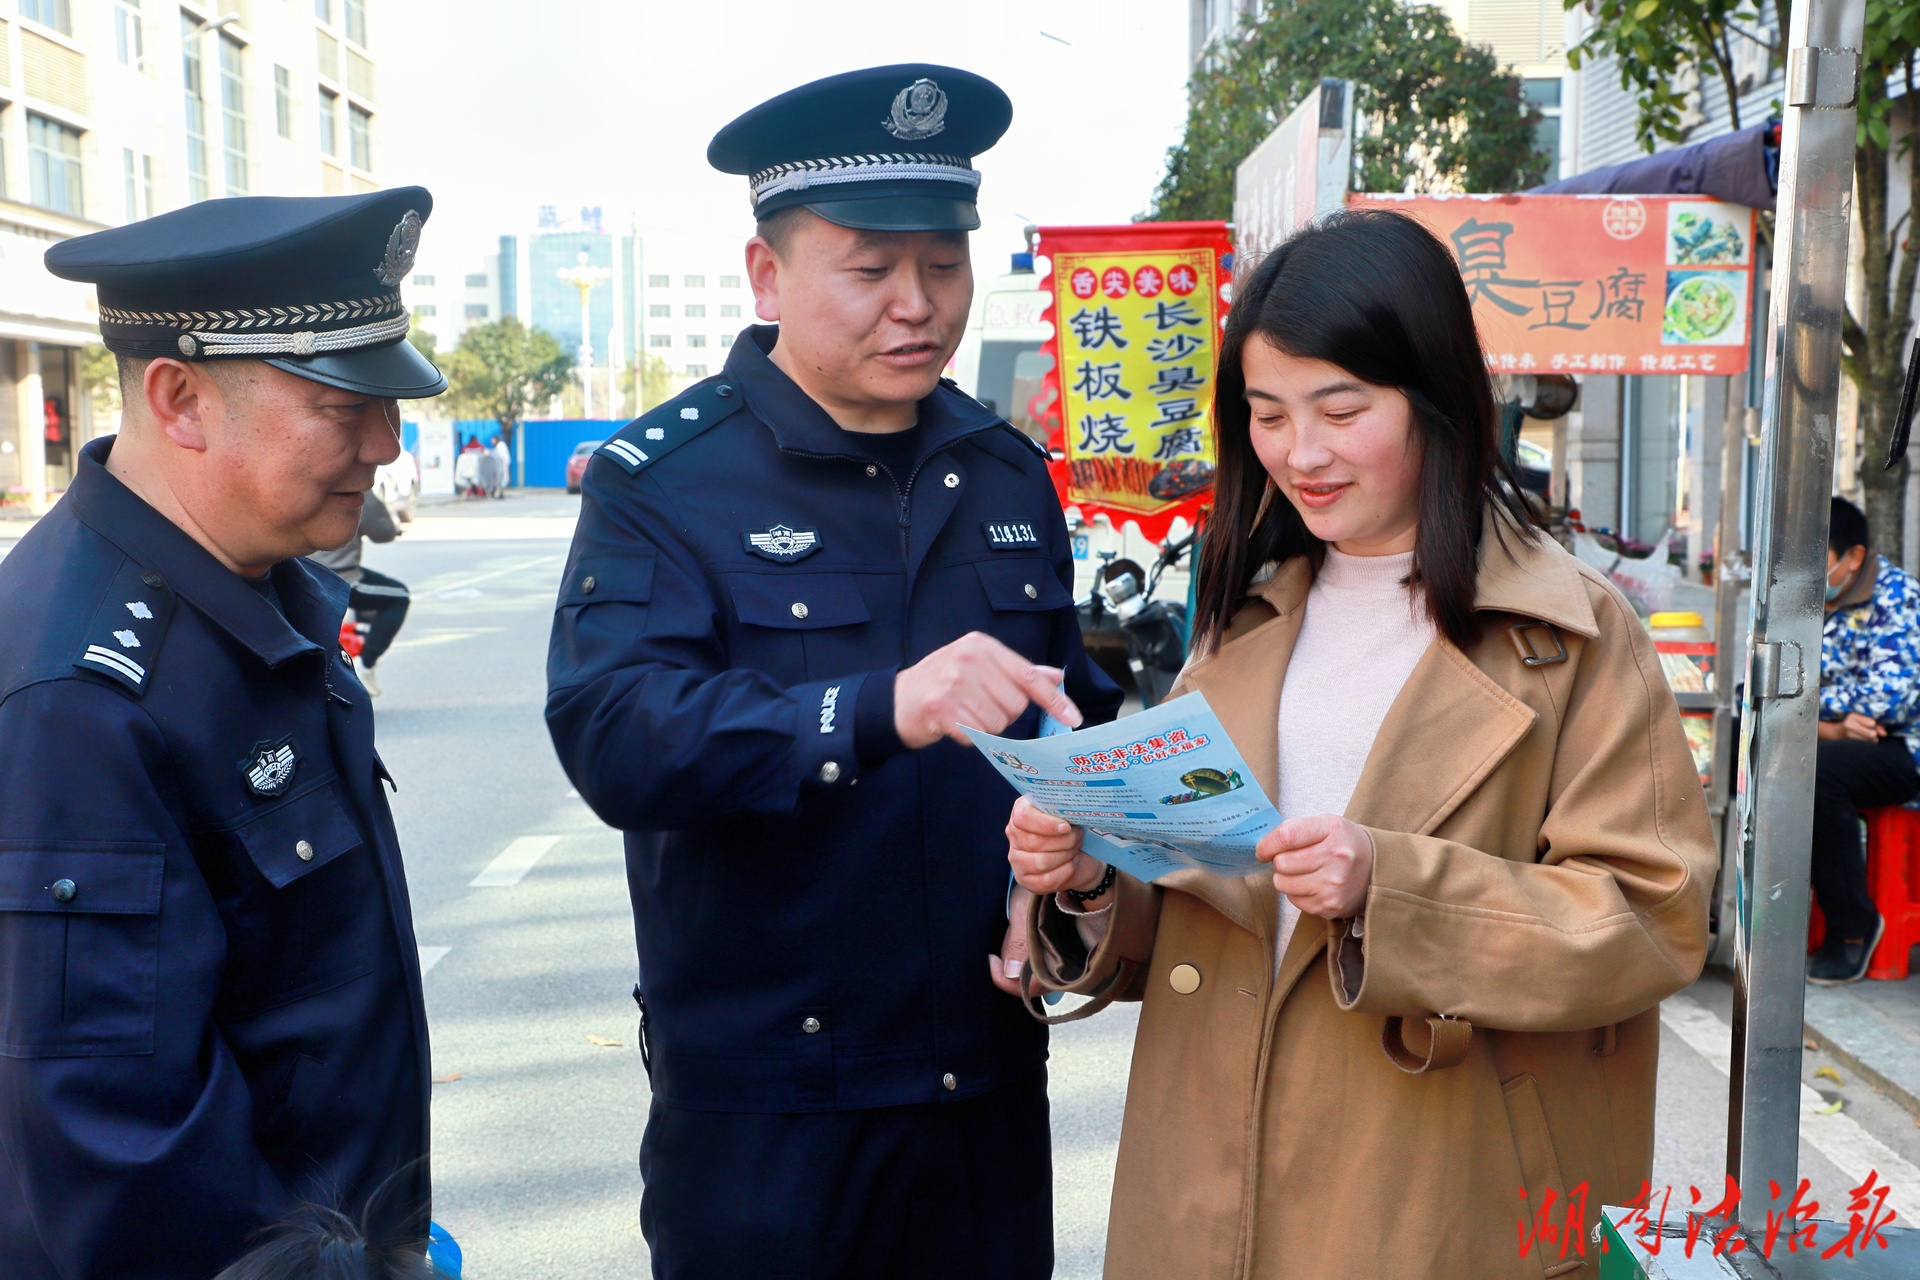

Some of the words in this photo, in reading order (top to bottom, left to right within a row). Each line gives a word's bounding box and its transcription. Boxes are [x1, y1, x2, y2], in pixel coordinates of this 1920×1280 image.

[1072, 265, 1196, 297] 舌尖美味
[1450, 217, 1646, 330] 臭豆腐
[1069, 306, 1135, 454] 铁板烧
[1143, 300, 1205, 459] 长沙臭豆腐
[989, 524, 1037, 543] 114131
[820, 686, 841, 734] POLICE
[1071, 729, 1187, 767] 防范非法集资
